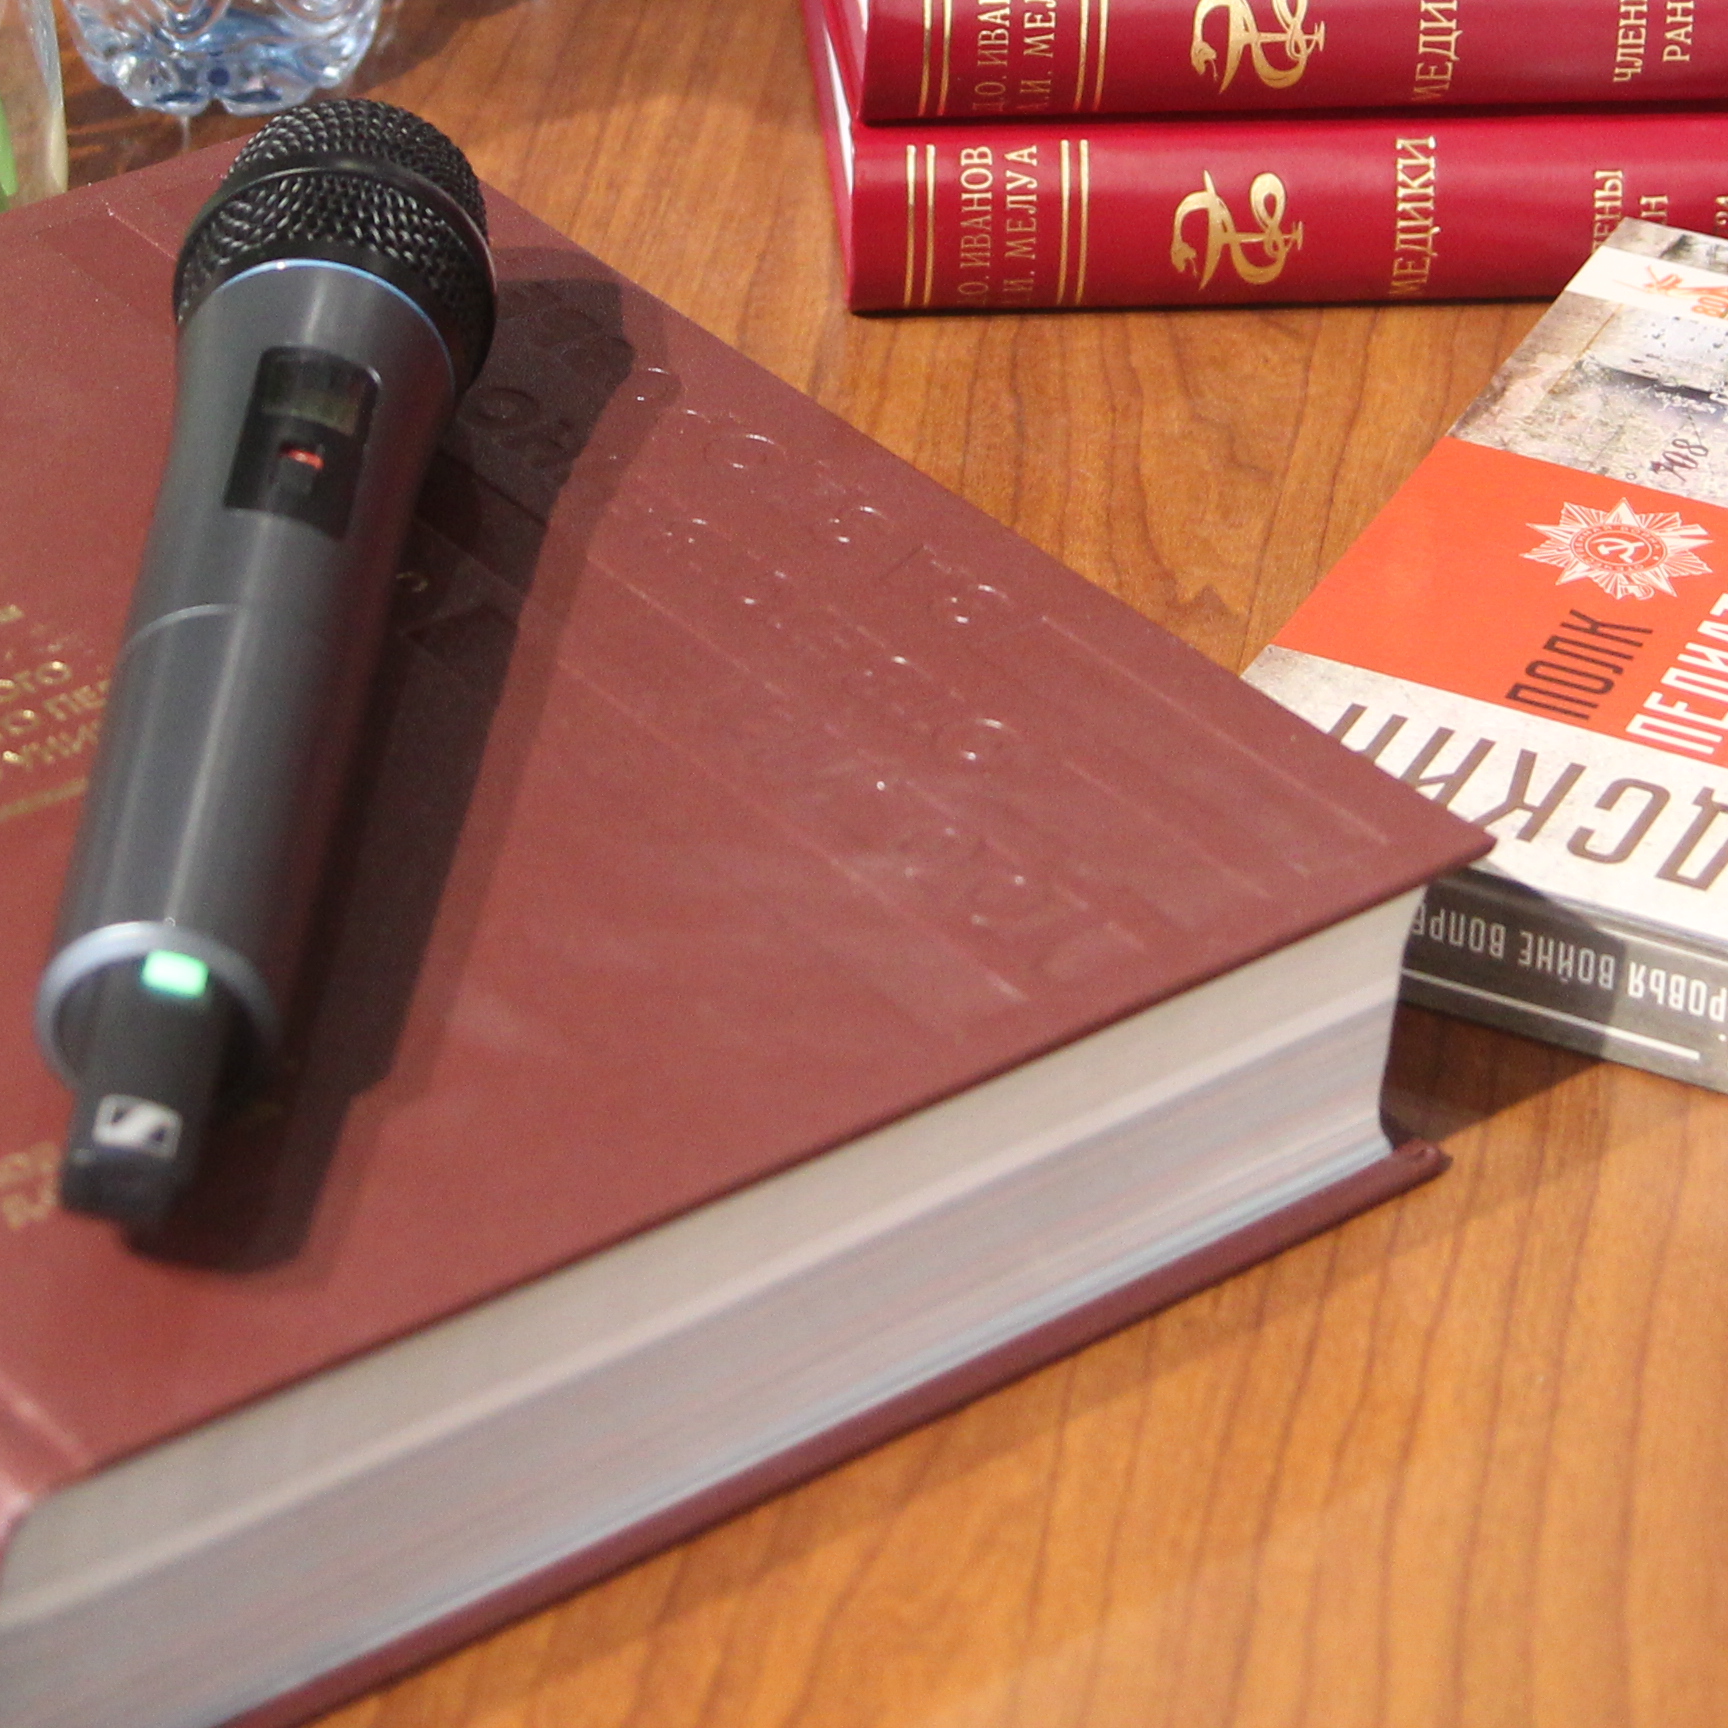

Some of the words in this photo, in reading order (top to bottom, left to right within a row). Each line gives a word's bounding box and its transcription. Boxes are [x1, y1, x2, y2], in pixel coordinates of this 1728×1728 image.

[960, 146, 993, 269] ИВАНОВ
[1005, 145, 1039, 259] МЕЛУА
[1388, 136, 1440, 297] МЕДИКИ
[1505, 609, 1652, 721] ПОЛК
[1410, 900, 1507, 957] ВОПРЕ
[1519, 933, 1614, 995] ВОЙНЕ
